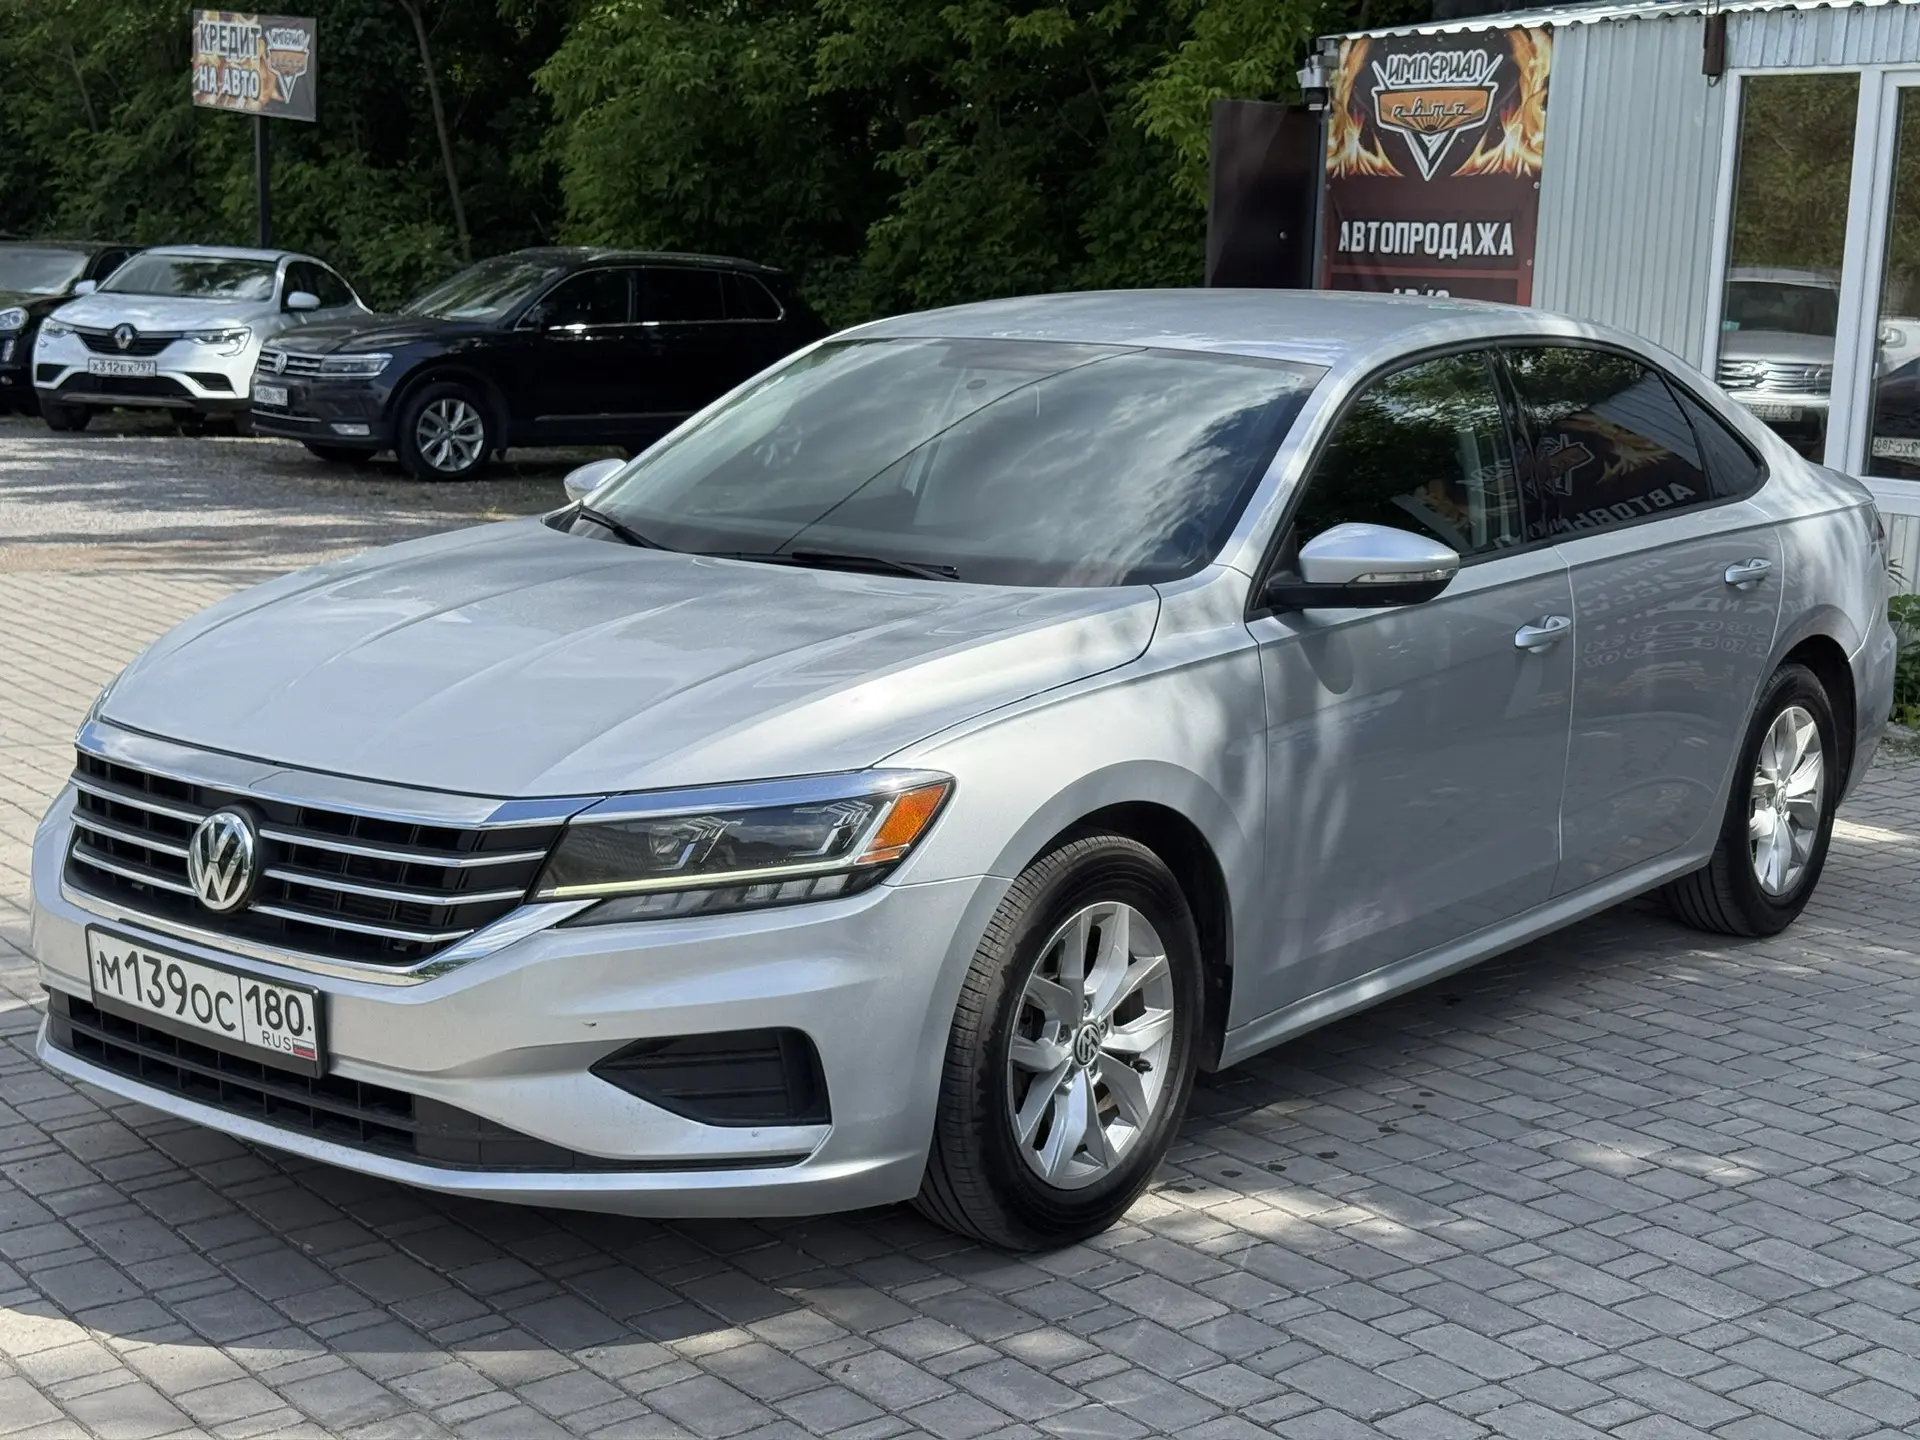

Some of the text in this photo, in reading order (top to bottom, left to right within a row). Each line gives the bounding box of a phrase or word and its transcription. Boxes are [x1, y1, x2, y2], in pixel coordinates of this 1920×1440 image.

[199, 22, 260, 59] КРЕДИТ
[199, 64, 260, 99] НА АВТО
[1386, 50, 1487, 82] ИМПЕРИАЛ
[1337, 220, 1515, 260] АВТОПРОДАЖА
[98, 950, 305, 1037] М139ОС 180
[262, 1030, 292, 1052] RUS
